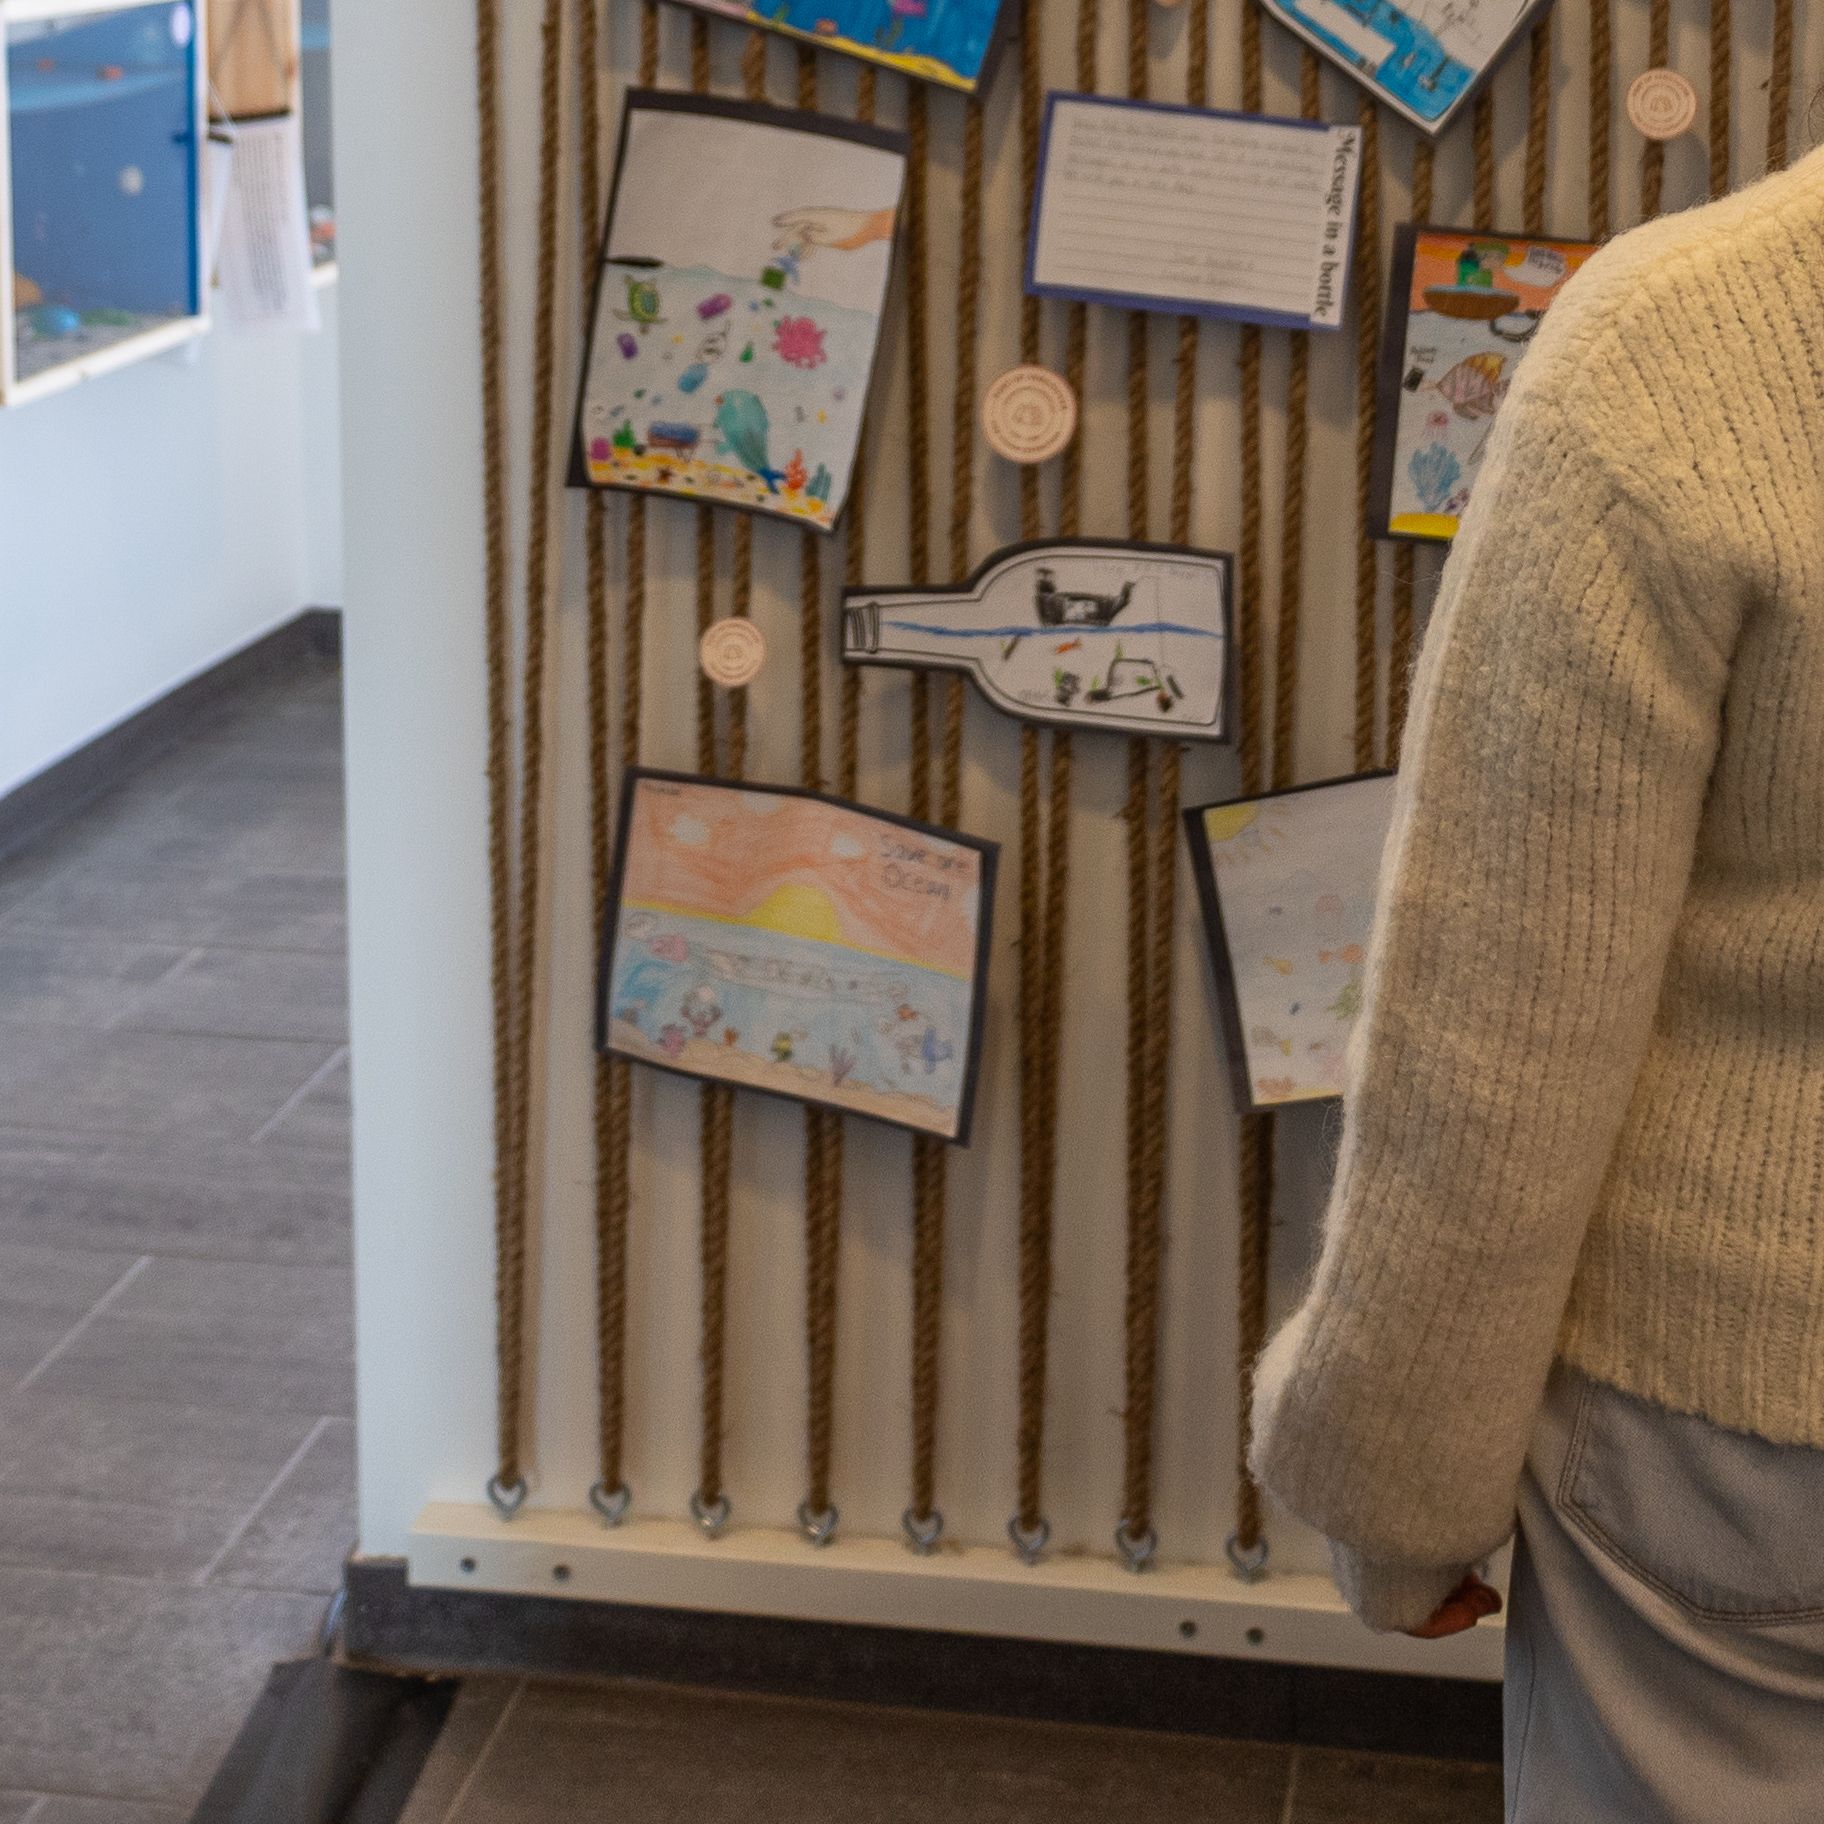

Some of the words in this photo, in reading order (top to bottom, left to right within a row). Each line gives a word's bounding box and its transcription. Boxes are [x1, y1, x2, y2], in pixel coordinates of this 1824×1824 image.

[1326, 132, 1355, 216] Message
[1325, 221, 1343, 240] in
[1322, 244, 1336, 255] a
[1314, 261, 1340, 317] bottle
